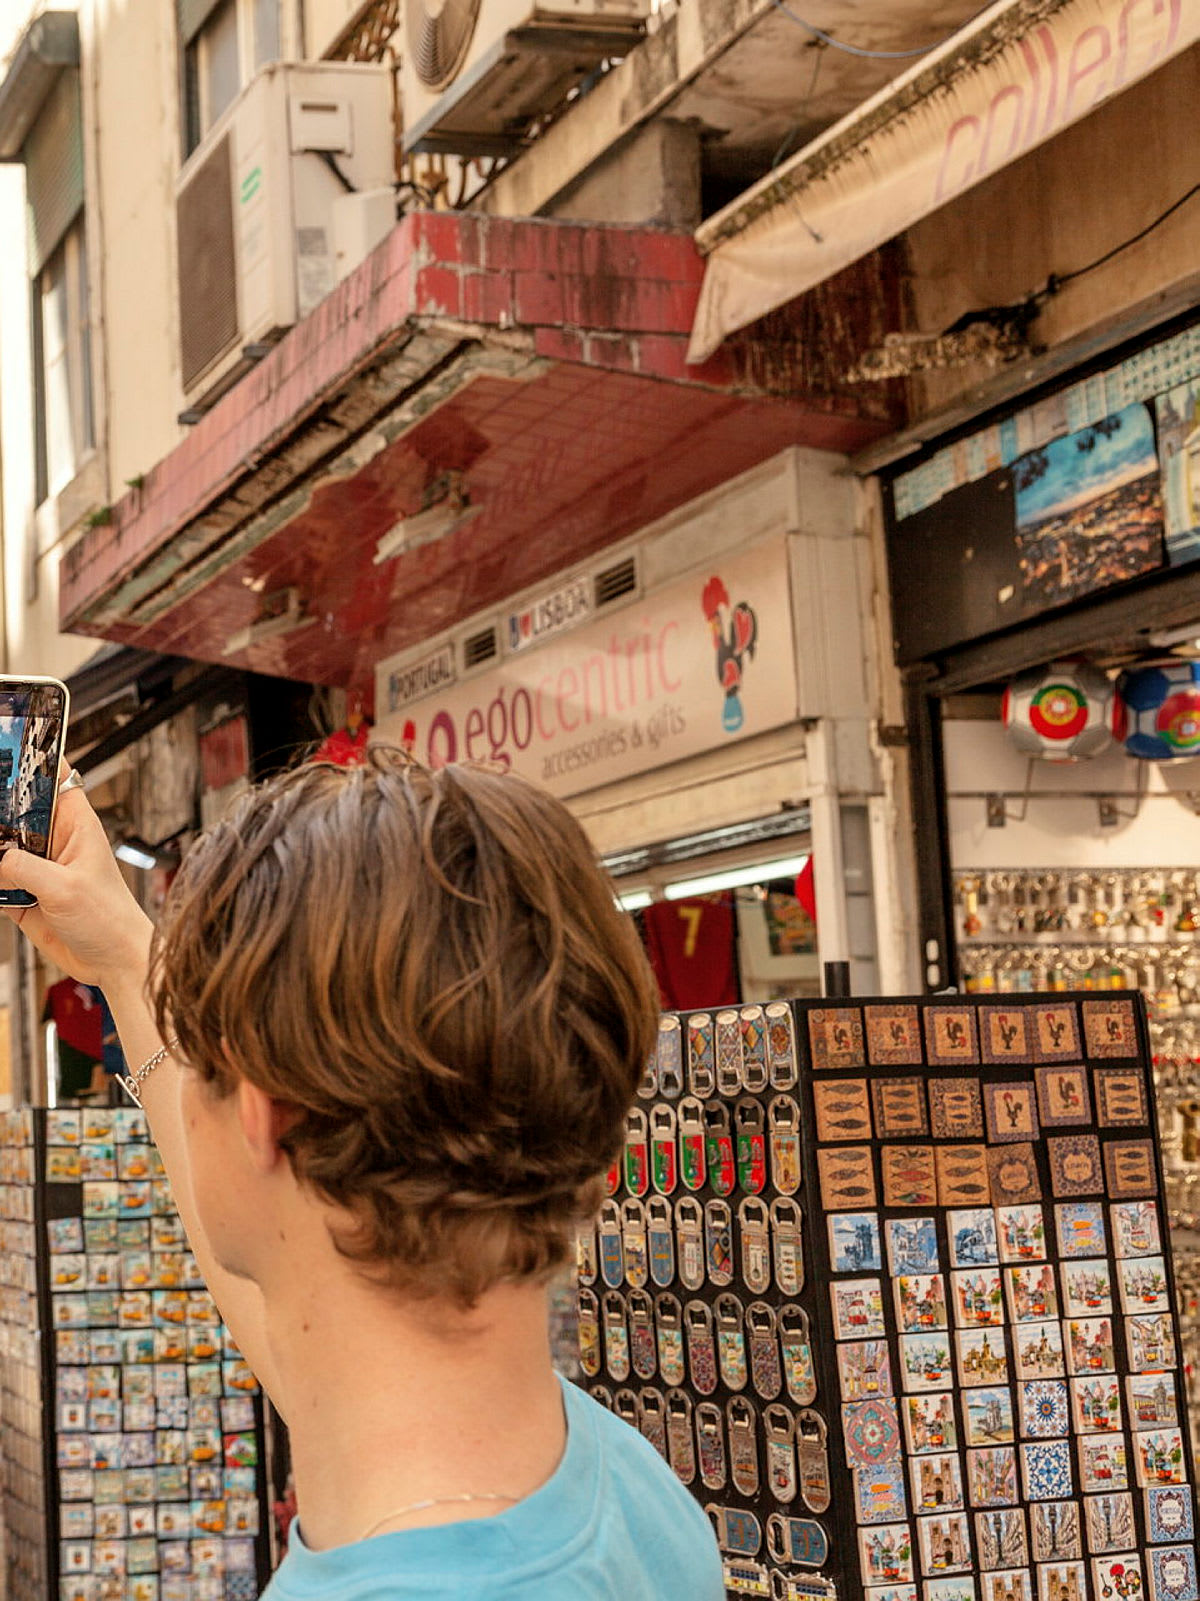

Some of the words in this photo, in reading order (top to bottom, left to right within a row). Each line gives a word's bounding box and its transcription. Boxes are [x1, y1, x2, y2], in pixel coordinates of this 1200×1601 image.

[533, 582, 589, 635] LISBOA
[399, 654, 450, 699] PORTUGAL
[465, 615, 682, 774] egocentric
[542, 727, 628, 780] accessories
[646, 703, 686, 749] gifts
[679, 906, 703, 957] 7
